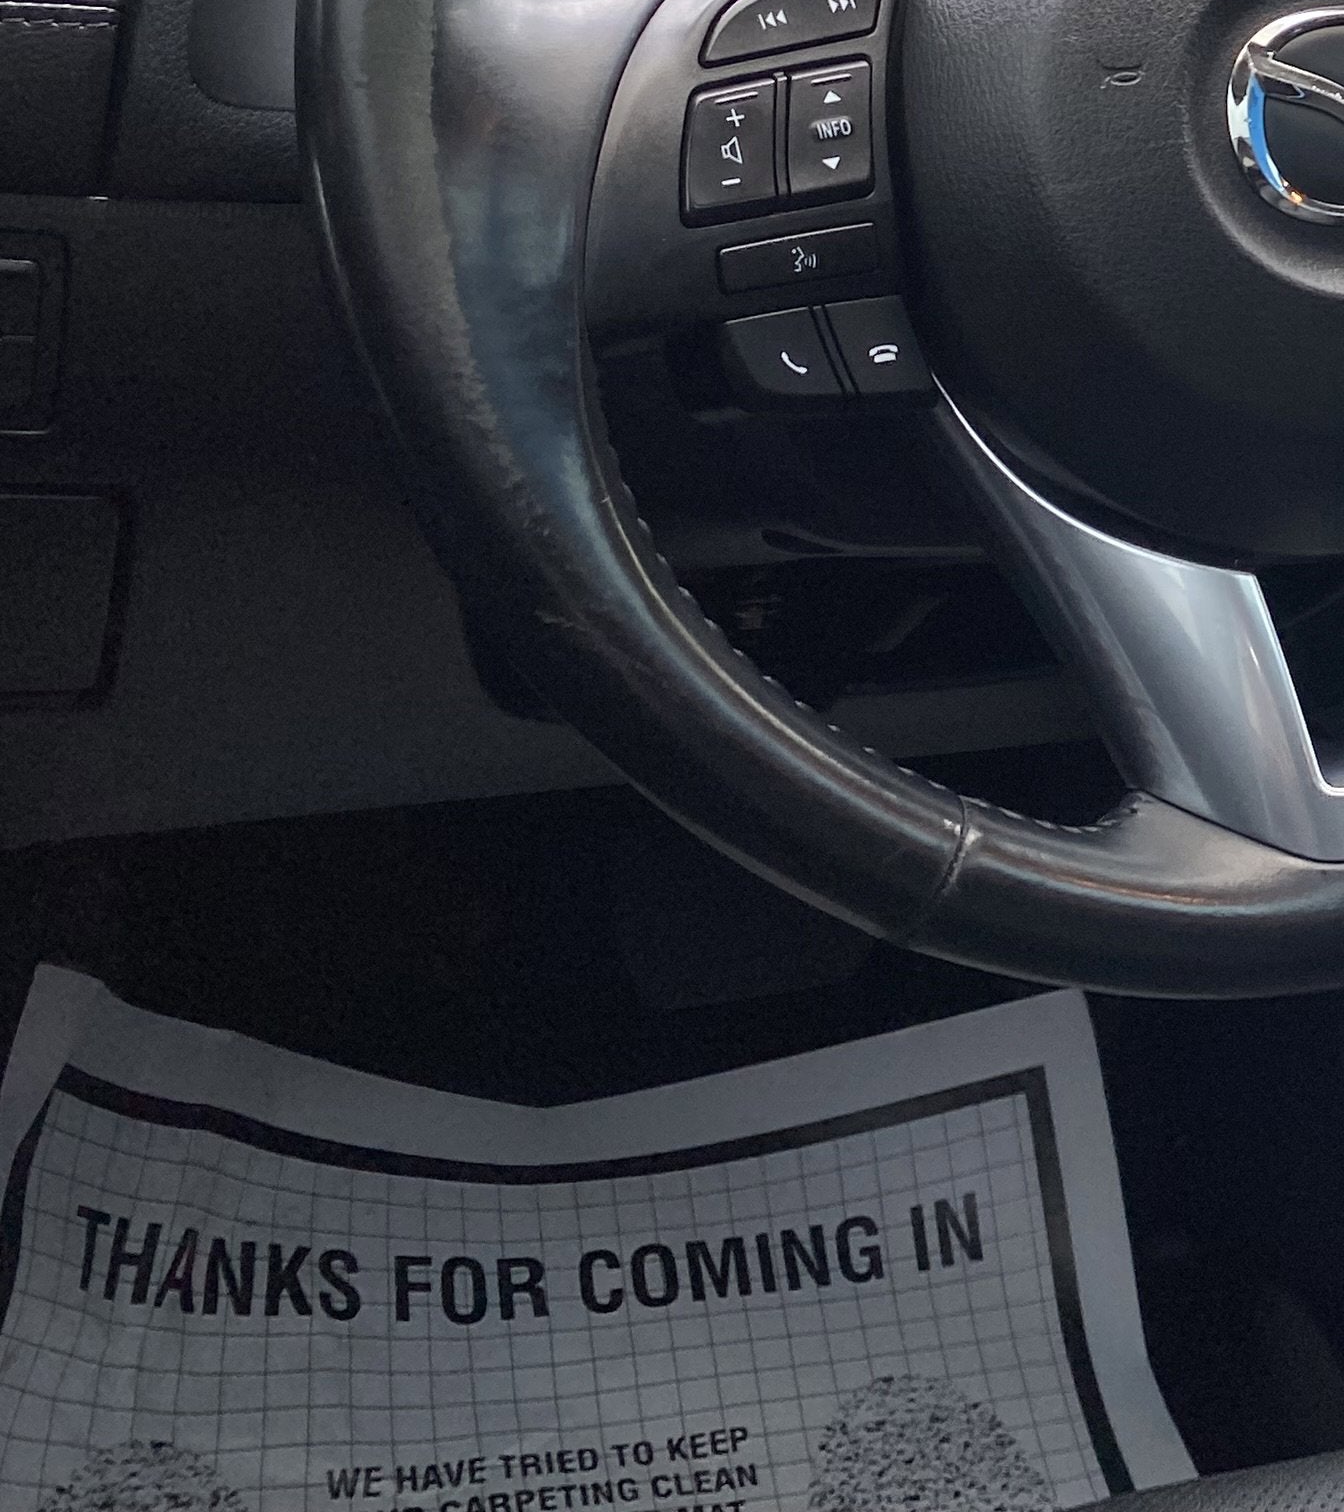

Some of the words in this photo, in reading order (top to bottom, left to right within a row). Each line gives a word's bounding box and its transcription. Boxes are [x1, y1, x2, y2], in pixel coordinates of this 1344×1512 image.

[816, 118, 851, 139] INFO
[76, 1204, 361, 1322] THANKS
[394, 1255, 550, 1326] FOR
[578, 1215, 884, 1314] COMING
[909, 1192, 983, 1272] IN
[325, 1465, 383, 1500] WE
[395, 1456, 487, 1492] HAVE
[499, 1447, 599, 1480] TRIED
[611, 1439, 654, 1468] TO
[666, 1426, 749, 1462] KEEP
[651, 1463, 759, 1499] CLEAN
